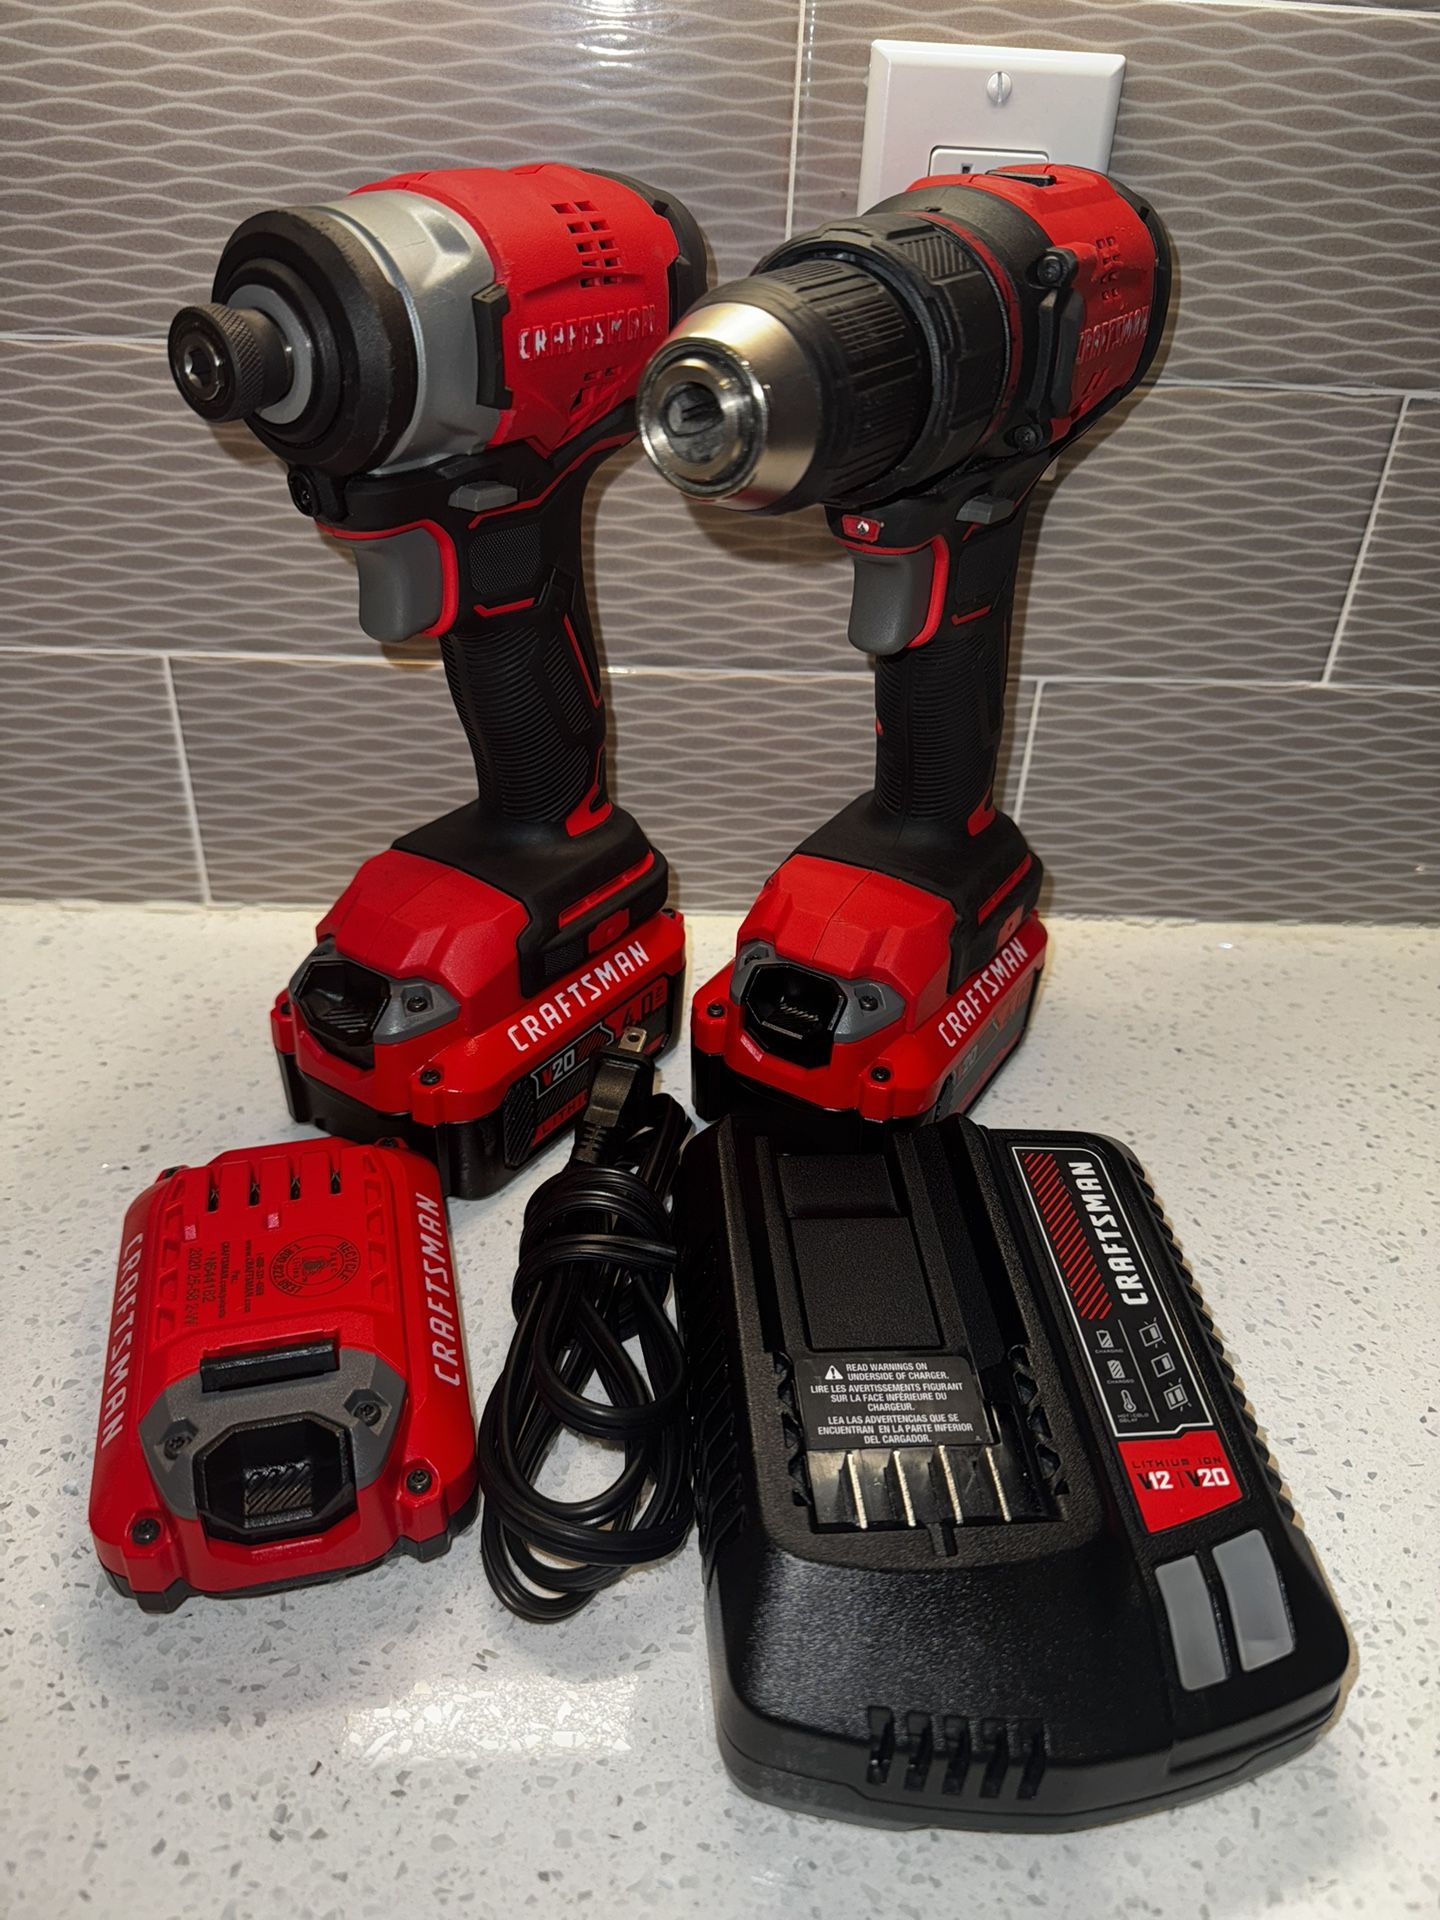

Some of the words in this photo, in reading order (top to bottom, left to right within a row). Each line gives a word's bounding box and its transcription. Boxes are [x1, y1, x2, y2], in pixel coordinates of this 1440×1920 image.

[507, 941, 650, 1052] CRAFTSMAN
[938, 936, 1028, 1048] CRAFTSMAN
[541, 1049, 575, 1087] V20
[1068, 1162, 1149, 1305] CRAFTSMAN
[336, 1241, 359, 1282] RECYCLE
[416, 1192, 461, 1387] CRAFTSMAN
[101, 1232, 144, 1449] CRAFTSMAN
[846, 1363, 868, 1371] READ
[870, 1363, 913, 1371] WARNINGS
[848, 1372, 894, 1381] UNDERSIDE
[896, 1372, 907, 1380] OF
[909, 1371, 949, 1380] CHARGER.
[811, 1385, 829, 1393] LIRE
[832, 1384, 846, 1393] LES
[849, 1383, 920, 1392] AVERTISSEMENTS
[923, 1383, 963, 1391] FIGURANT
[831, 1395, 848, 1403] SUR
[851, 1394, 861, 1402] LA
[863, 1394, 884, 1402] FACE
[935, 1392, 947, 1400] DU
[868, 1403, 915, 1412] CHARGEUR.
[828, 1416, 844, 1424] LEA
[846, 1415, 863, 1424] LAS
[865, 1414, 927, 1424] ADVERTENCIAS
[930, 1414, 946, 1423] QUE
[948, 1414, 959, 1422] SE
[818, 1426, 874, 1435] ENCUENTRAN
[879, 1425, 889, 1434] EN
[892, 1425, 903, 1433] LA
[906, 1424, 933, 1432] PARTE
[935, 1423, 973, 1432] INFERIOR
[864, 1435, 880, 1444] DEL
[882, 1434, 931, 1443] CARGADOR.
[1196, 1456, 1221, 1465] ION
[1137, 1470, 1174, 1490] V12
[1185, 1467, 1230, 1487] V20
